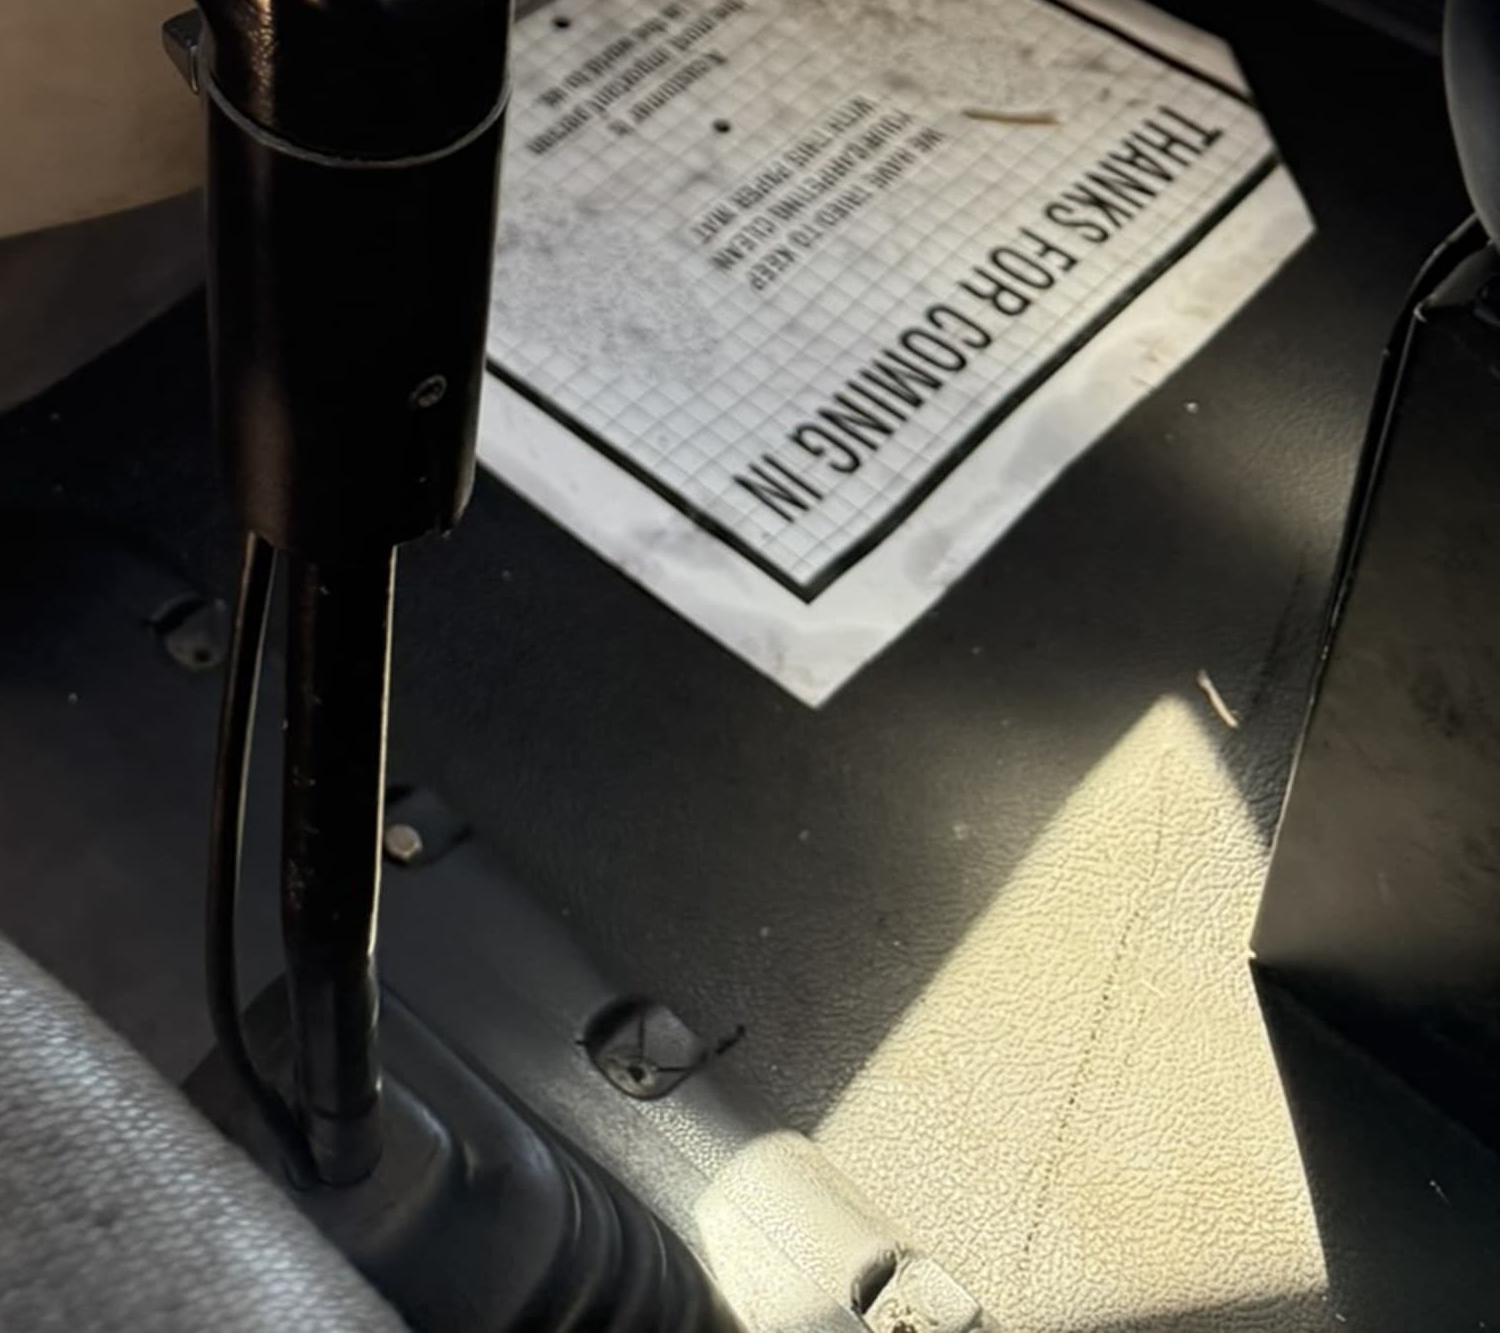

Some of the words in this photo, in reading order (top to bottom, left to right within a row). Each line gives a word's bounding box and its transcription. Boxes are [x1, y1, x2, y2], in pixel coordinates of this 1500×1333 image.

[1040, 103, 1223, 250] THANKS
[956, 223, 1077, 323] FOR
[787, 296, 994, 480] COMING
[729, 452, 823, 528] IN
